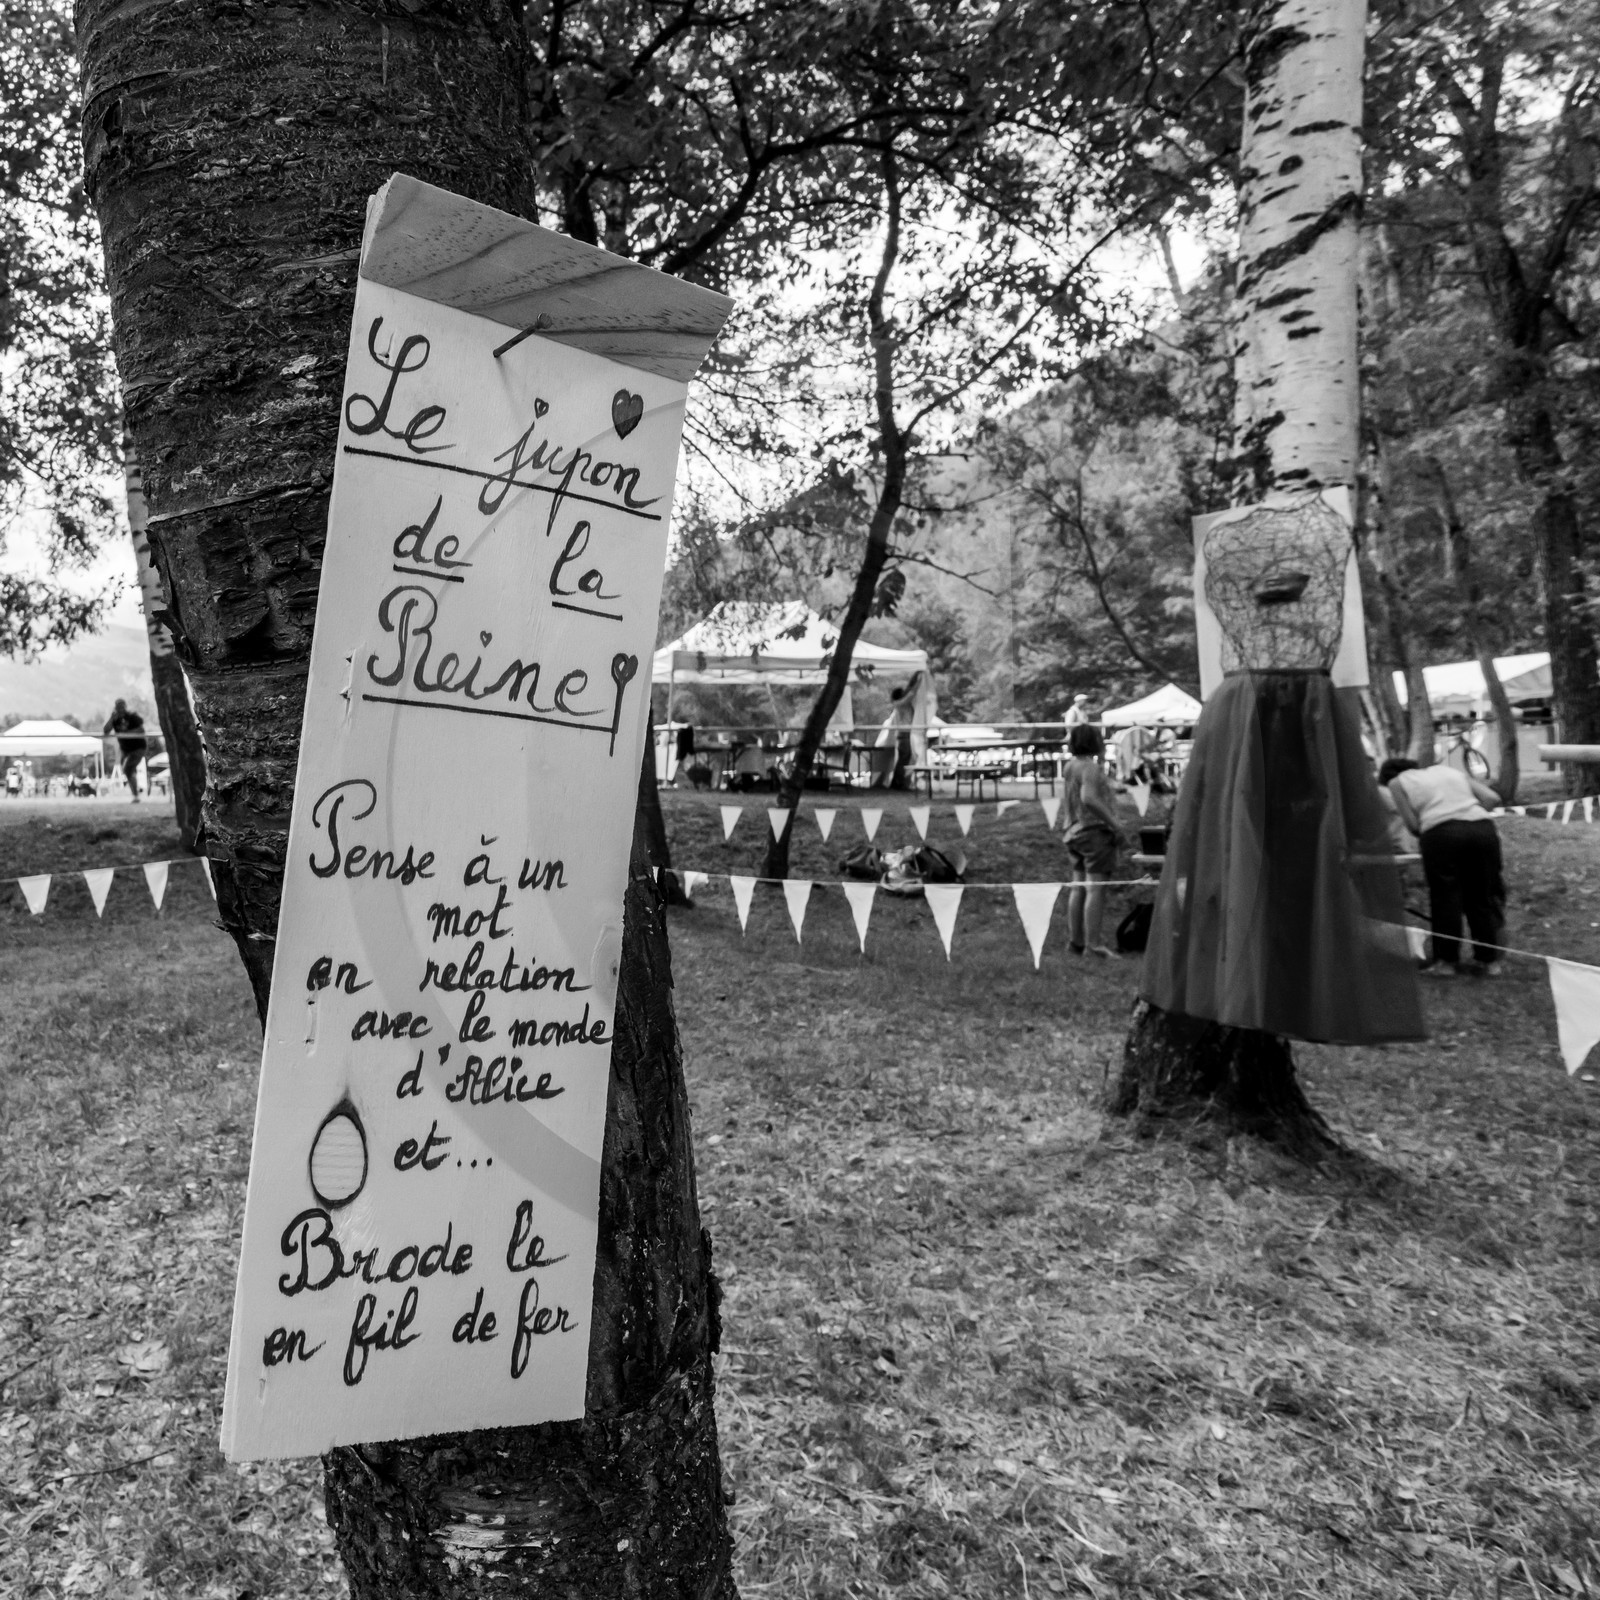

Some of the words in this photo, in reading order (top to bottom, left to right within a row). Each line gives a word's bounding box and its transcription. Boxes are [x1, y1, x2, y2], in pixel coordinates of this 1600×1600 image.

[345, 317, 456, 453] Le
[478, 398, 666, 536] jupon
[394, 495, 472, 567] de
[549, 521, 621, 600] la
[366, 585, 607, 716] Reine
[309, 779, 435, 885] Pense
[464, 834, 507, 886] à
[519, 857, 568, 891] un
[427, 885, 514, 942] mot
[306, 956, 373, 993] en
[419, 941, 593, 993] relation
[351, 1010, 433, 1041] avec
[459, 990, 495, 1043] le
[509, 1002, 613, 1047] monde
[394, 1120, 493, 1171] et...
[278, 1208, 473, 1297] Brode
[506, 1200, 569, 1272] le
[263, 1327, 326, 1367] en
[343, 1286, 421, 1386] fil
[452, 1286, 499, 1344] de
[510, 1278, 578, 1379] fer
